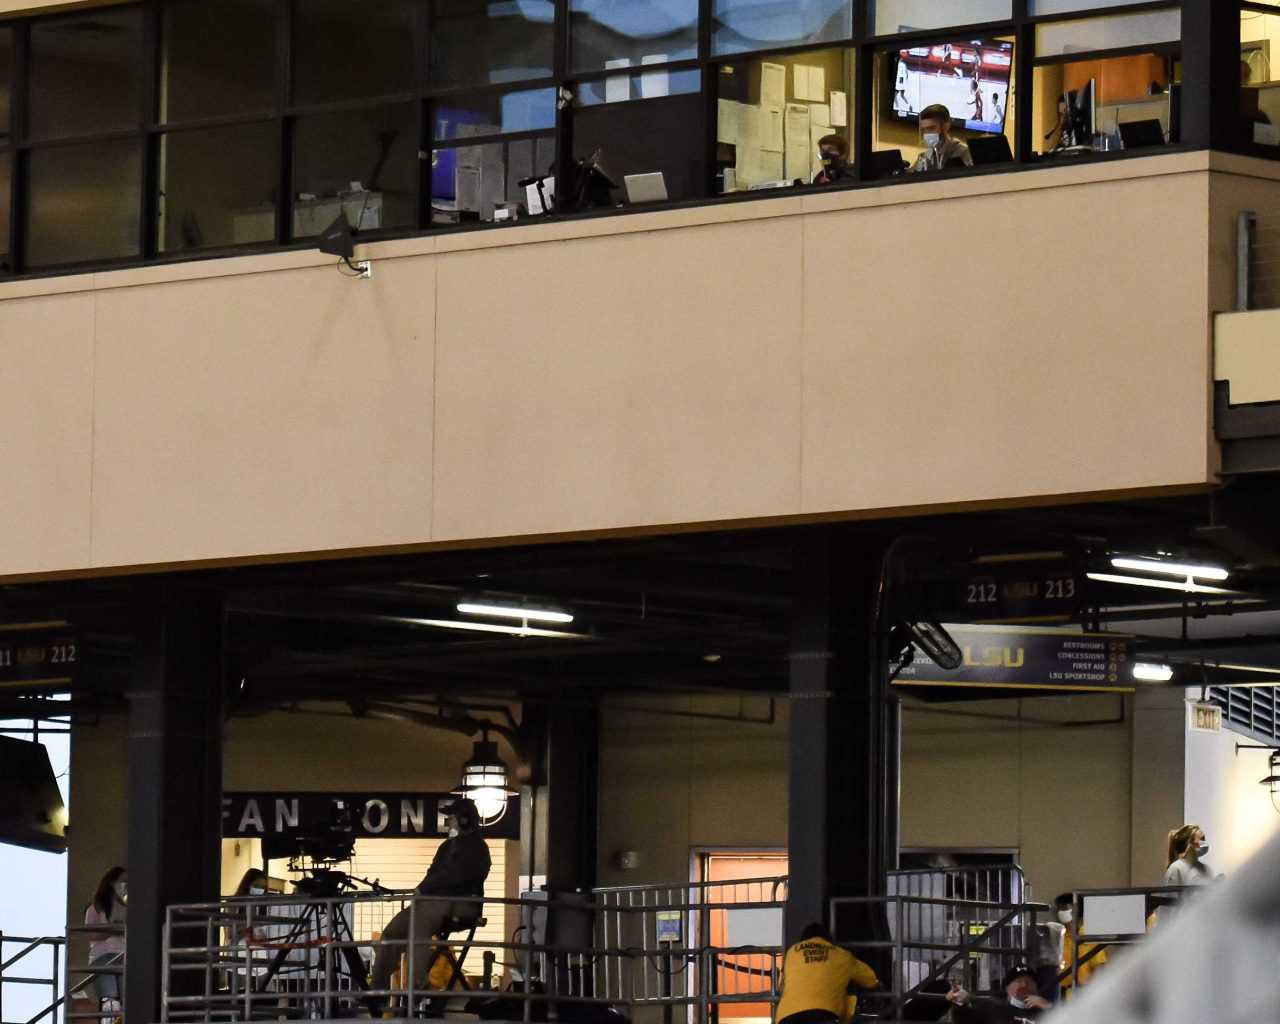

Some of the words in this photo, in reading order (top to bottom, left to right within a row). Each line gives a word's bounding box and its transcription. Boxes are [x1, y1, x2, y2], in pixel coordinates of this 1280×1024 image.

[967, 583, 997, 603] 212
[1045, 579, 1075, 598] 213
[50, 644, 76, 663] 212
[962, 646, 1024, 668] LSU
[1049, 672, 1063, 680] LSU
[1064, 673, 1105, 681] SPORTSHOP
[1093, 663, 1105, 671] AID
[1196, 707, 1216, 729] EXIT
